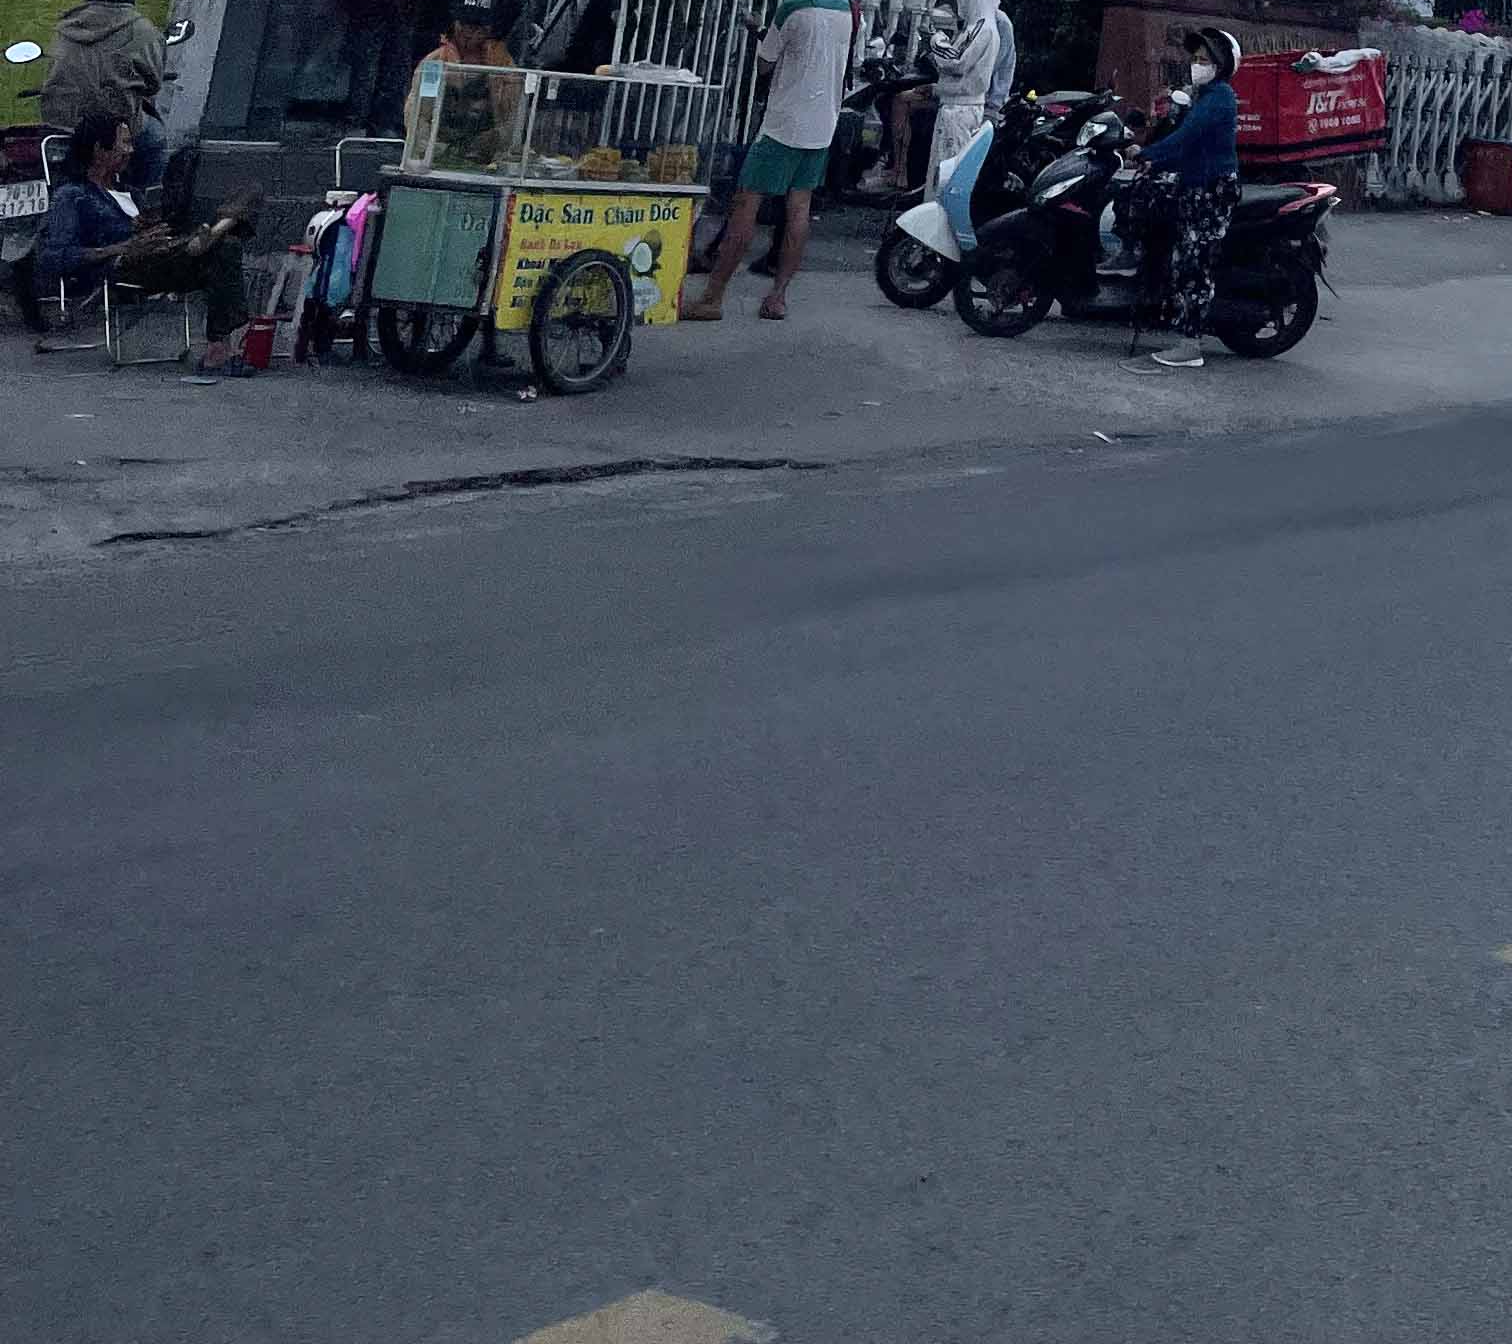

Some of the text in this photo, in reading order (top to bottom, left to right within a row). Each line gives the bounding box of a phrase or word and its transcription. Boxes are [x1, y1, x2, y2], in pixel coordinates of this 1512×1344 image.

[1306, 89, 1345, 115] J&T
[519, 202, 554, 229] Đặc
[650, 198, 680, 222] Đốc
